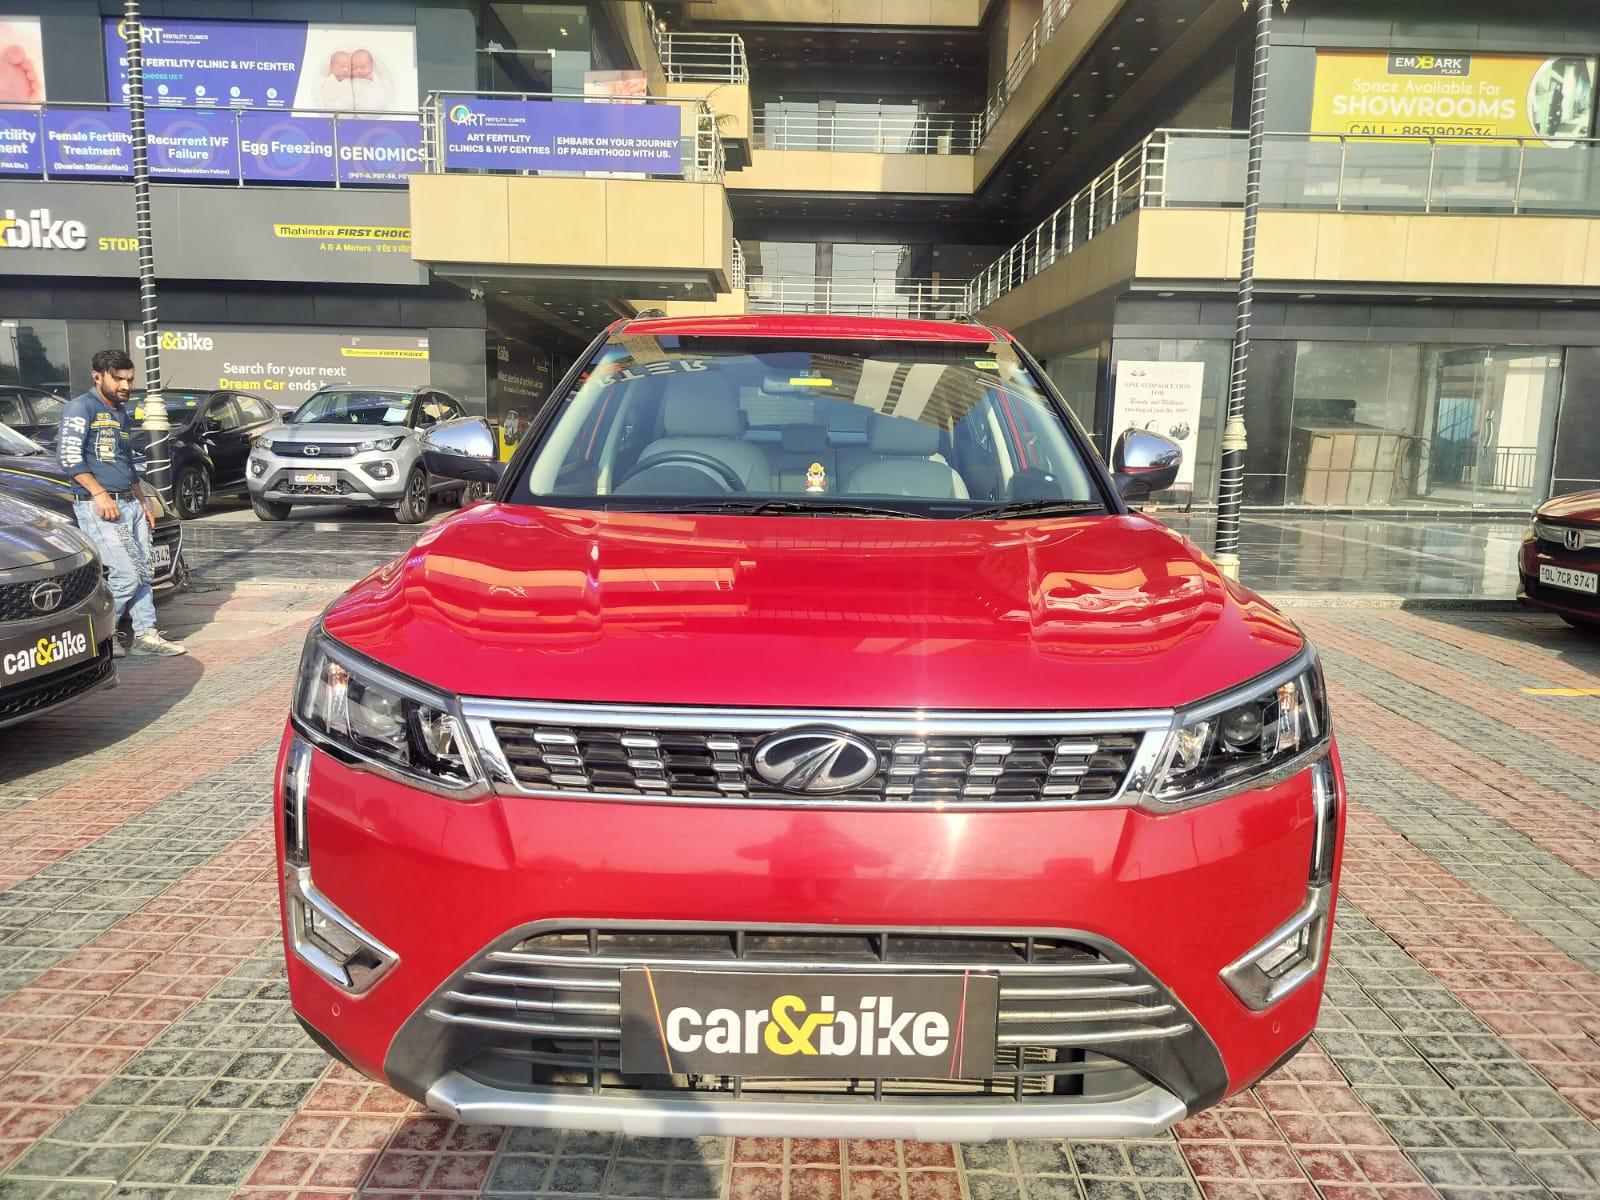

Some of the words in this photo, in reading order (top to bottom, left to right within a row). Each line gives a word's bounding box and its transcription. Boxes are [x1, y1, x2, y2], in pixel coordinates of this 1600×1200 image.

[140, 28, 163, 43] RT
[119, 57, 145, 66] BT
[147, 58, 194, 68] FERTILITY
[197, 60, 229, 69] CLINIC
[231, 61, 238, 69] &
[240, 61, 256, 70] IVF
[257, 62, 295, 71] CENTER
[1353, 78, 1400, 93] Space
[1405, 79, 1473, 95] Available
[1479, 81, 1501, 95] For
[1332, 94, 1516, 120] SHOWROOMS
[457, 113, 486, 126] ART
[48, 130, 88, 142] Female
[89, 131, 133, 144] Fertility
[147, 134, 208, 146] Recurrent
[210, 136, 229, 147] IVF
[467, 133, 485, 142] ART
[486, 134, 531, 143] FERTILITY
[557, 136, 594, 146] EMBARK
[596, 137, 608, 146] ON
[610, 138, 634, 147] YOUR
[635, 139, 678, 148] JOURNEY
[64, 145, 122, 156] Treatment
[168, 148, 209, 160] Failure
[241, 140, 268, 156] Egg
[271, 141, 333, 158] Freezing
[340, 146, 424, 162] GENOMICS
[449, 144, 484, 153] CLINICS
[486, 145, 492, 153] &
[494, 145, 508, 153] IVF
[509, 146, 550, 154] CENTRES
[557, 147, 569, 155] OF
[570, 148, 631, 157] PARENTHOOD
[632, 149, 654, 158] WITH
[656, 150, 671, 158] US.
[54, 162, 84, 170] (Ovarian
[85, 163, 129, 171] Stimulation)
[280, 226, 335, 236] Mahindra
[337, 228, 372, 237] FIRST
[374, 229, 410, 238] CHOIC
[98, 237, 140, 252] STOR
[320, 242, 326, 250] A
[343, 244, 372, 252] Motors
[135, 331, 214, 350] cr&bike
[223, 362, 264, 374] Search
[267, 362, 285, 374] for
[288, 365, 316, 377] your
[319, 365, 347, 377] next
[219, 378, 260, 390] Dream
[263, 379, 285, 390] Car
[288, 379, 317, 391] ends
[69, 416, 86, 434] OF
[294, 473, 331, 483] car&bike
[1545, 568, 1554, 582] DL
[1557, 571, 1572, 585] 7CR
[1574, 574, 1595, 590] 9741
[3, 630, 87, 675] car&bike
[665, 994, 949, 1057] car&bike
